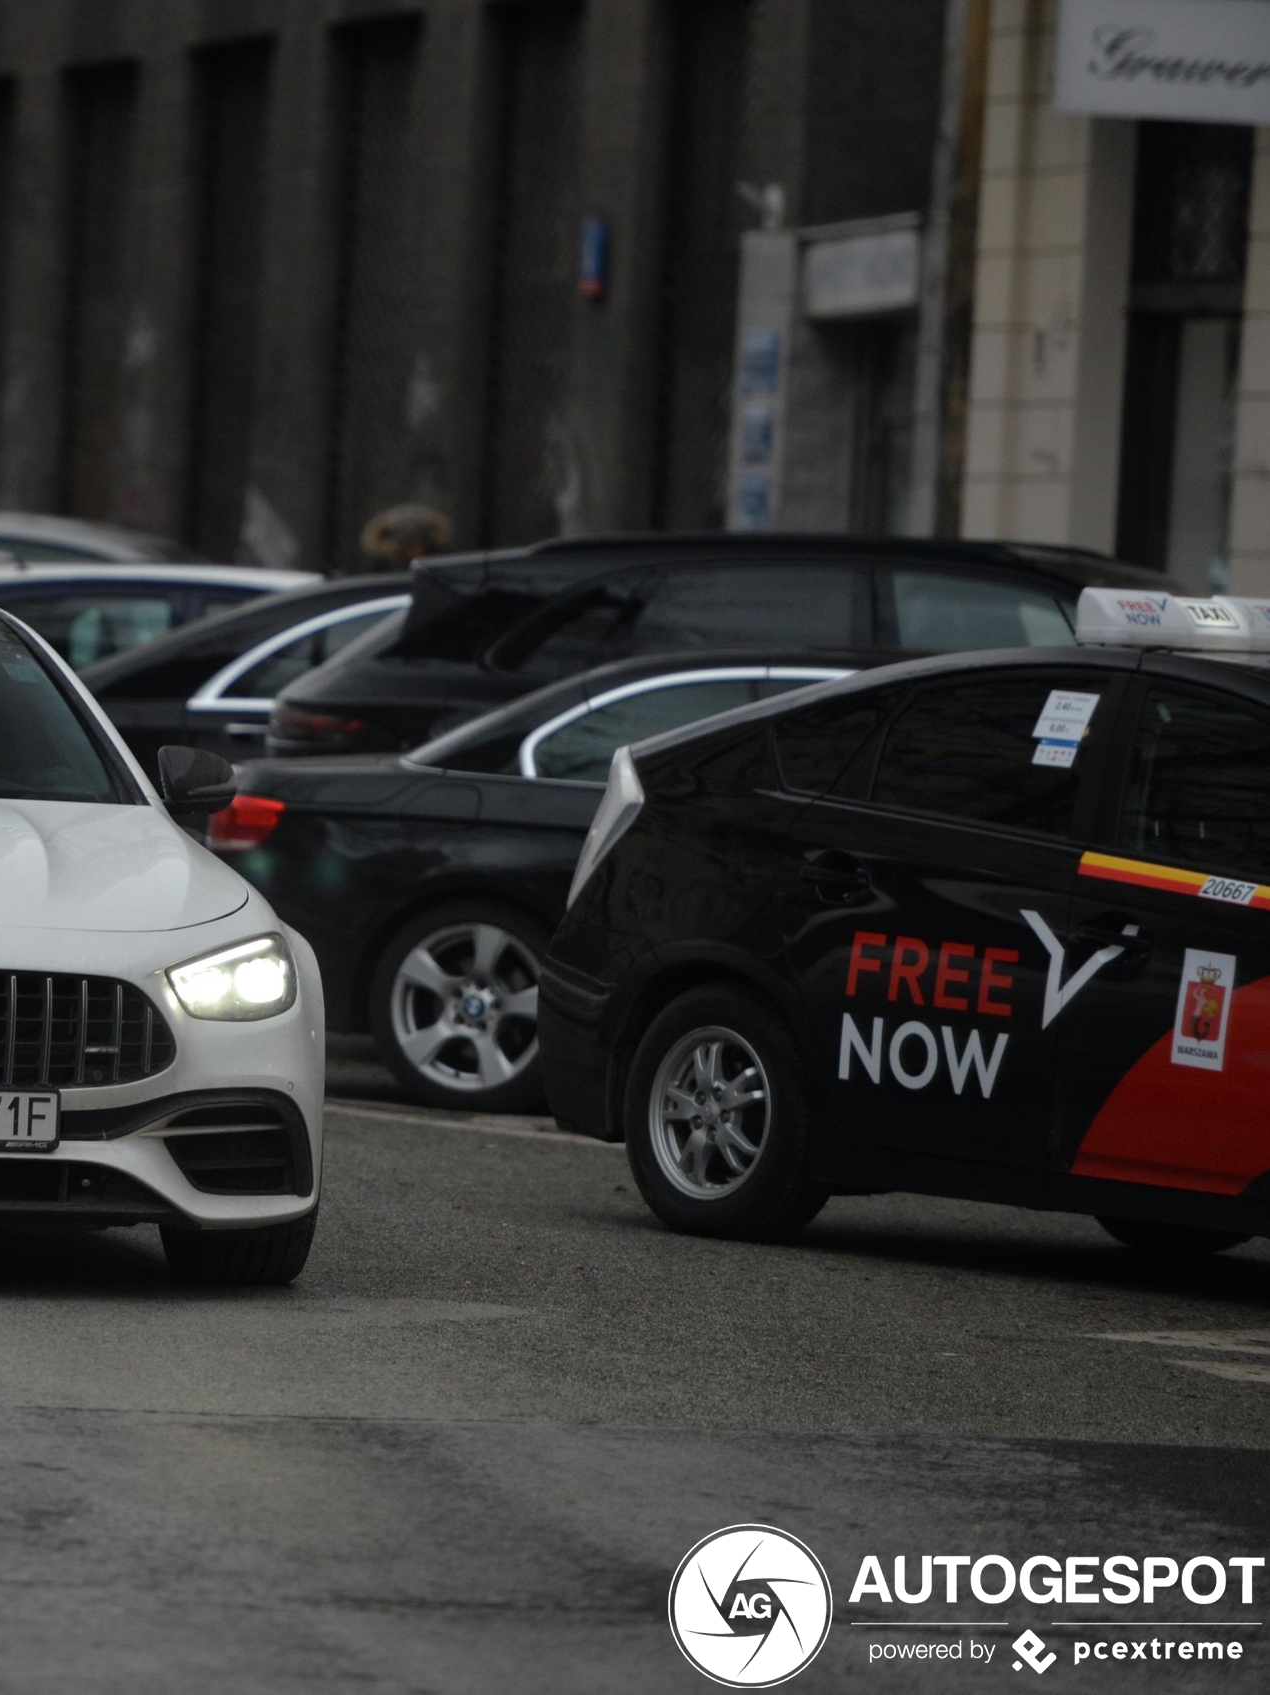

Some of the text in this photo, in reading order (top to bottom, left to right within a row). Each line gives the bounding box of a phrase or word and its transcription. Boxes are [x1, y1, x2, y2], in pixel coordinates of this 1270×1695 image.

[1117, 599, 1158, 613] FREE
[1187, 605, 1232, 622] TAXI
[1126, 612, 1161, 626] NOW
[1201, 878, 1256, 901] 20667
[846, 930, 1020, 1016] FREE
[838, 1012, 1010, 1099] NOW
[1176, 1045, 1219, 1060] WARSZAWA
[18, 1141, 48, 1149] AMG
